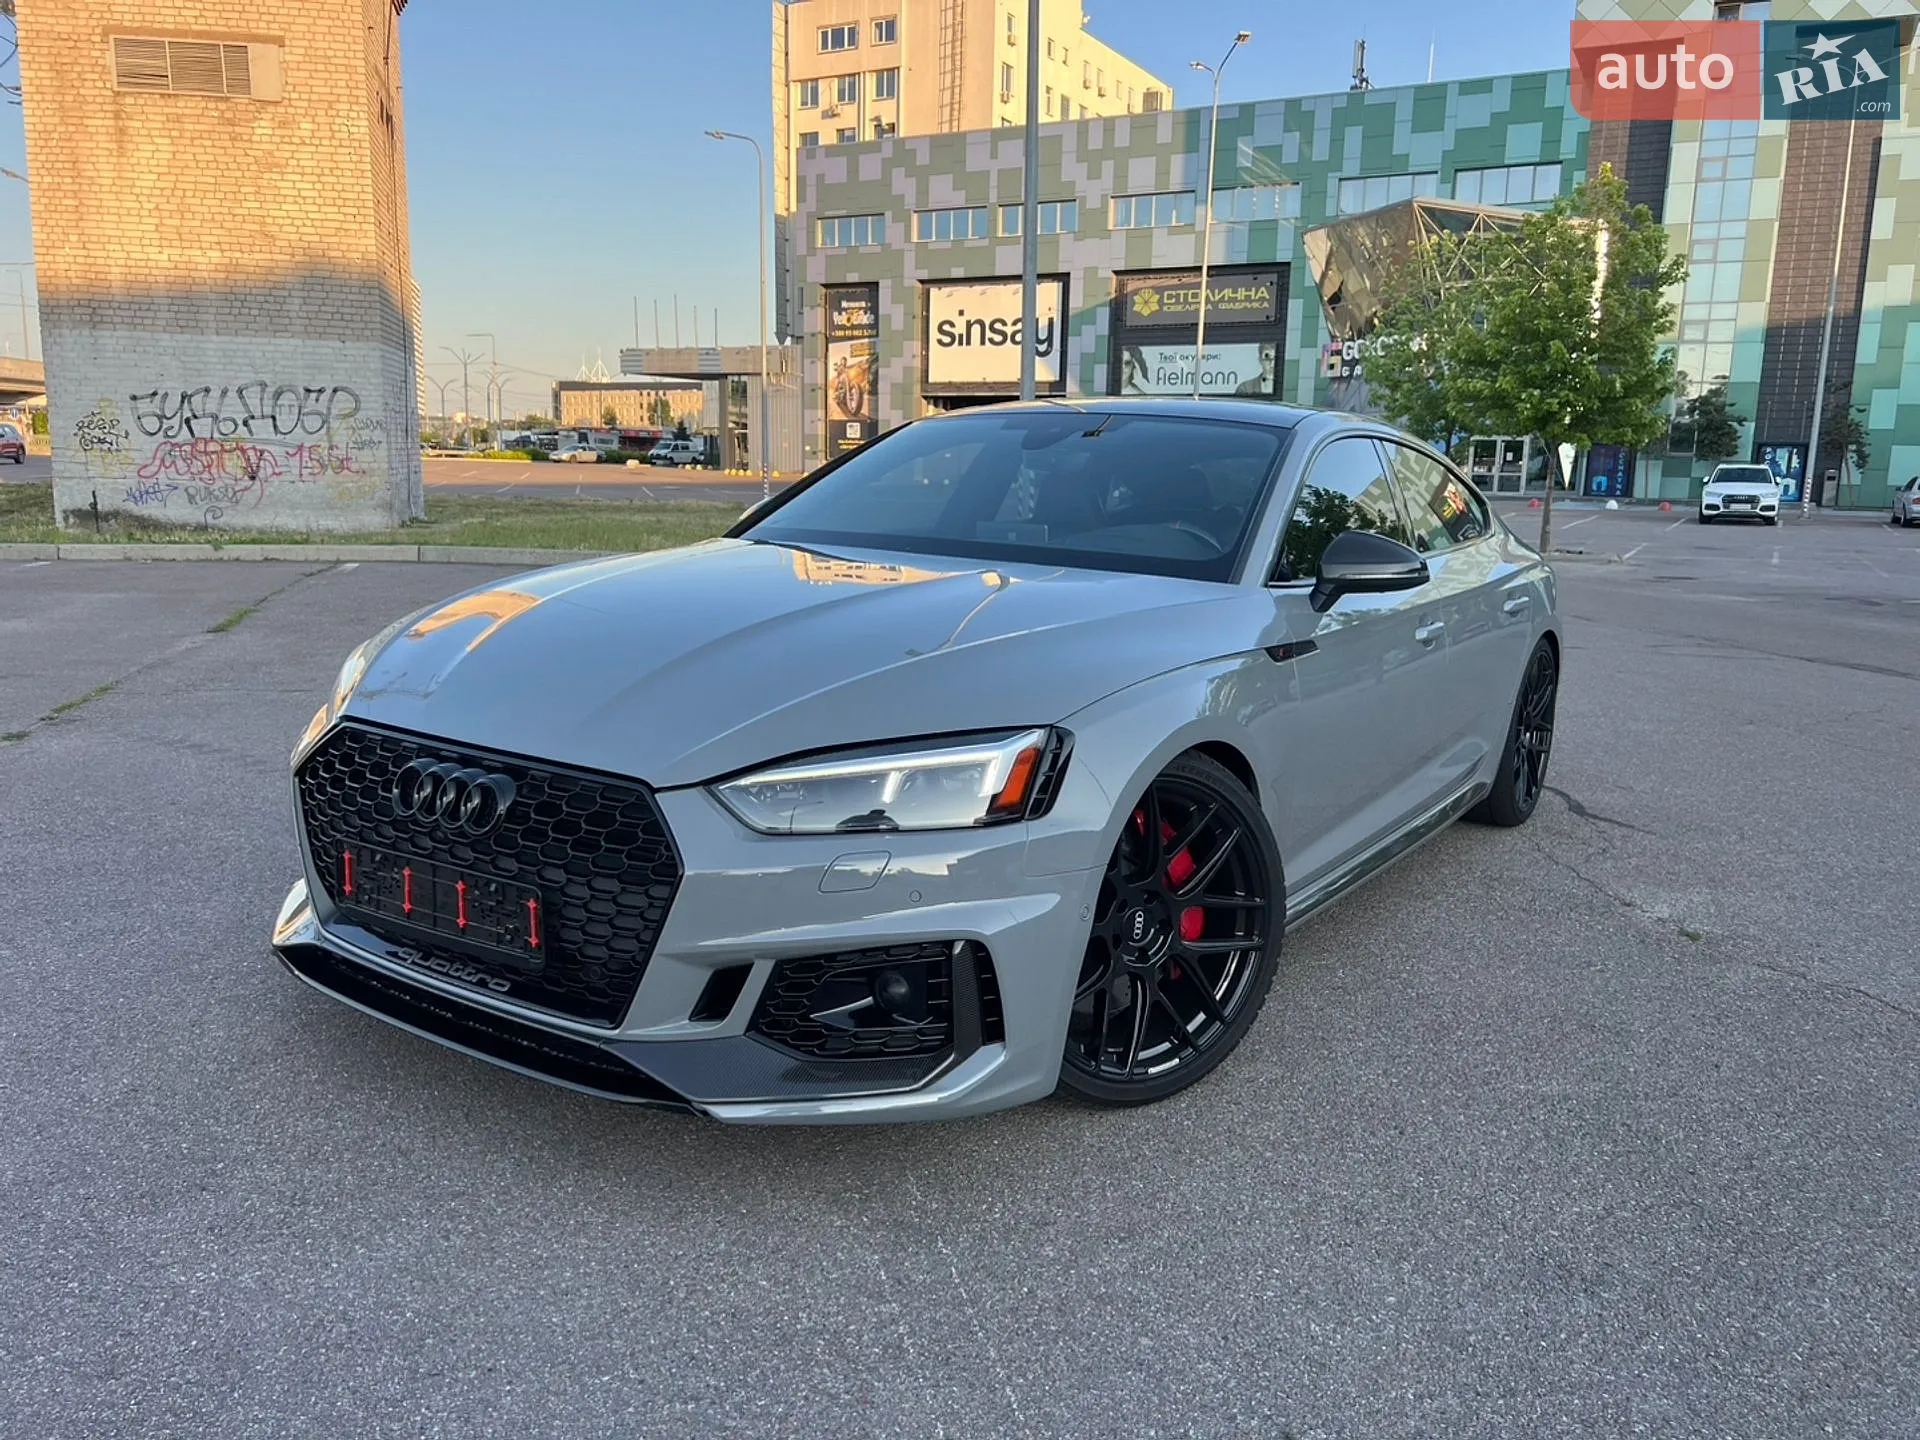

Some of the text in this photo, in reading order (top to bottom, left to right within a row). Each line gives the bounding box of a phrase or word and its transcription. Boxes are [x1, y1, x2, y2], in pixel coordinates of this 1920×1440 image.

[1163, 286, 1270, 303] СТОЛИЧНА
[936, 309, 1054, 357] sinsay
[398, 946, 511, 992] quattro
